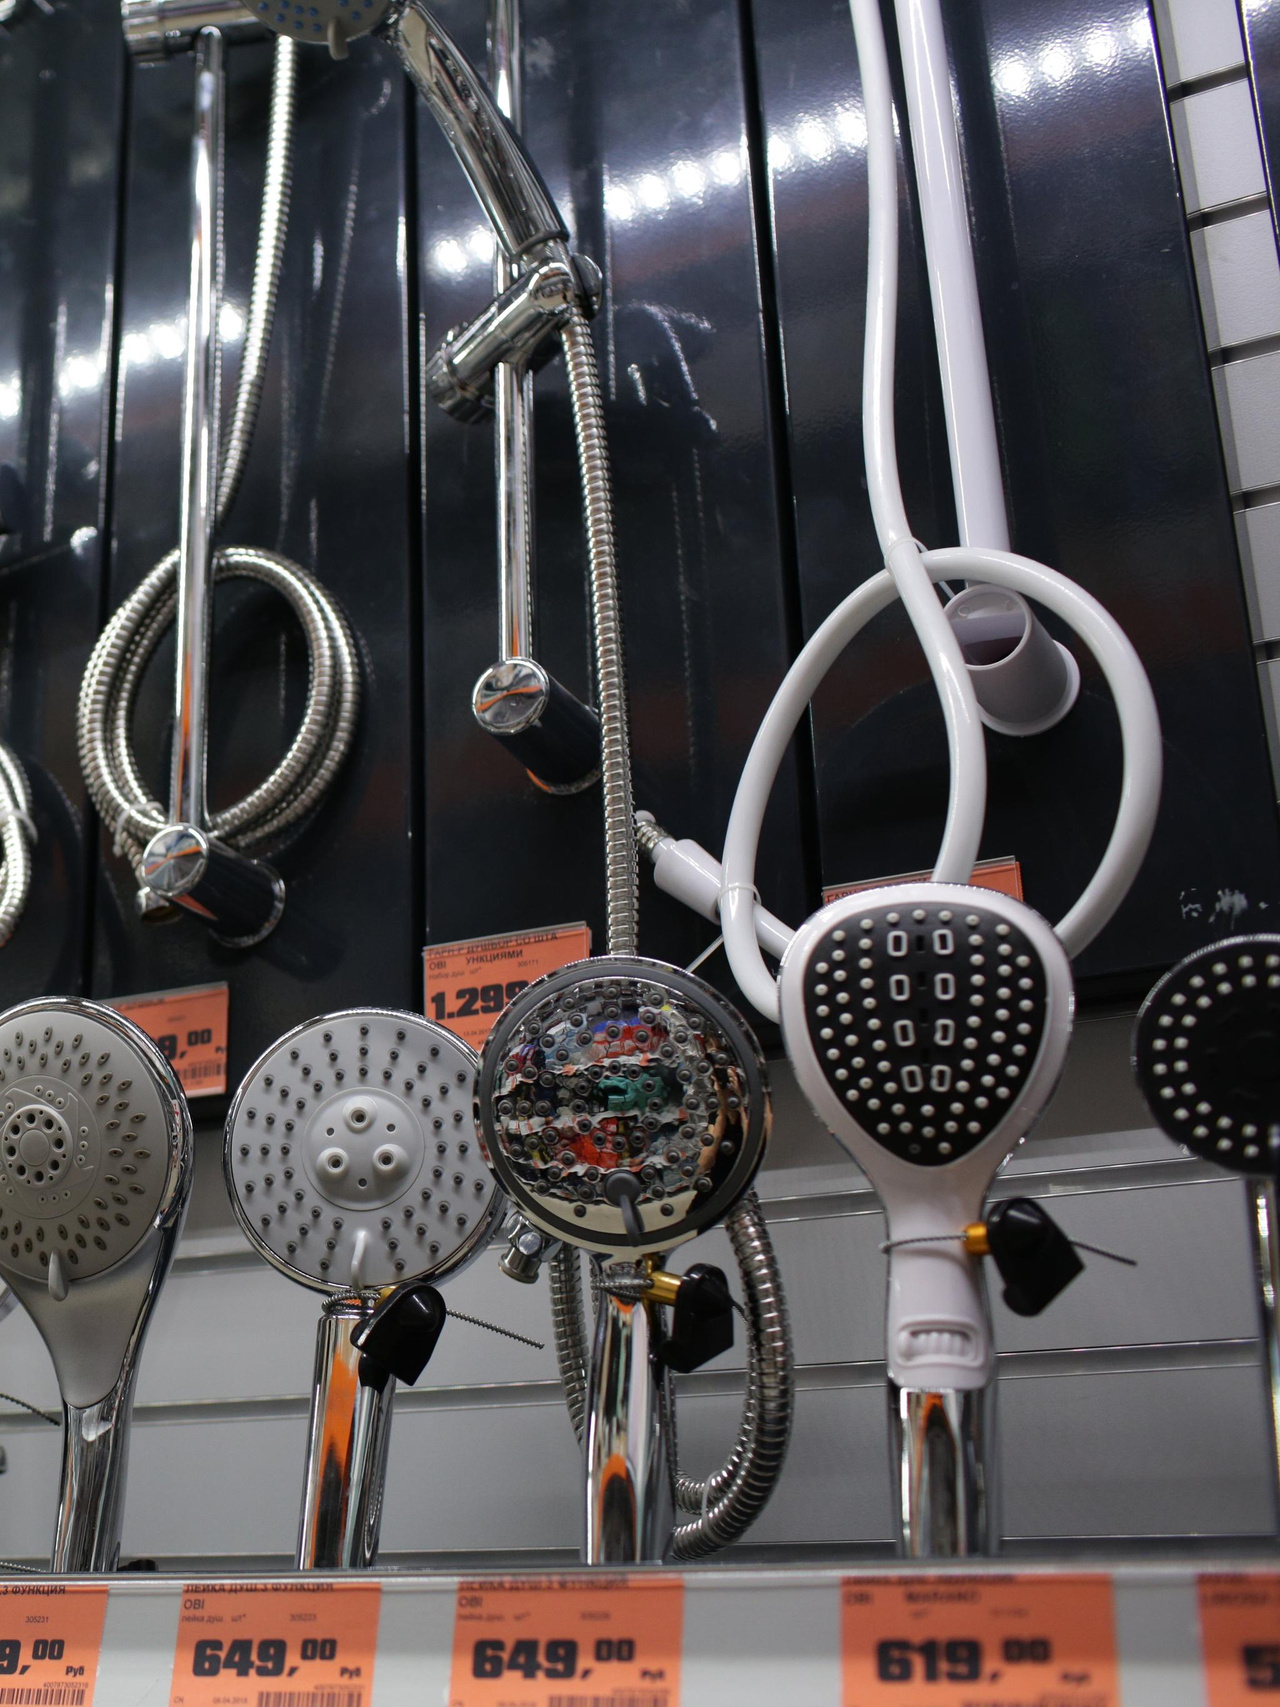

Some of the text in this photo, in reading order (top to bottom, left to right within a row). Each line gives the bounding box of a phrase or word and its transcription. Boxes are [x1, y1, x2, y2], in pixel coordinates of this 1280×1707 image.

[429, 961, 447, 971] OBI
[11, 1585, 66, 1597] ФУНКЦИЯ
[183, 1598, 205, 1610] OBI
[192, 1638, 338, 1677] 649,00
[472, 1638, 636, 1680] 649,00
[65, 1665, 85, 1678] Руб
